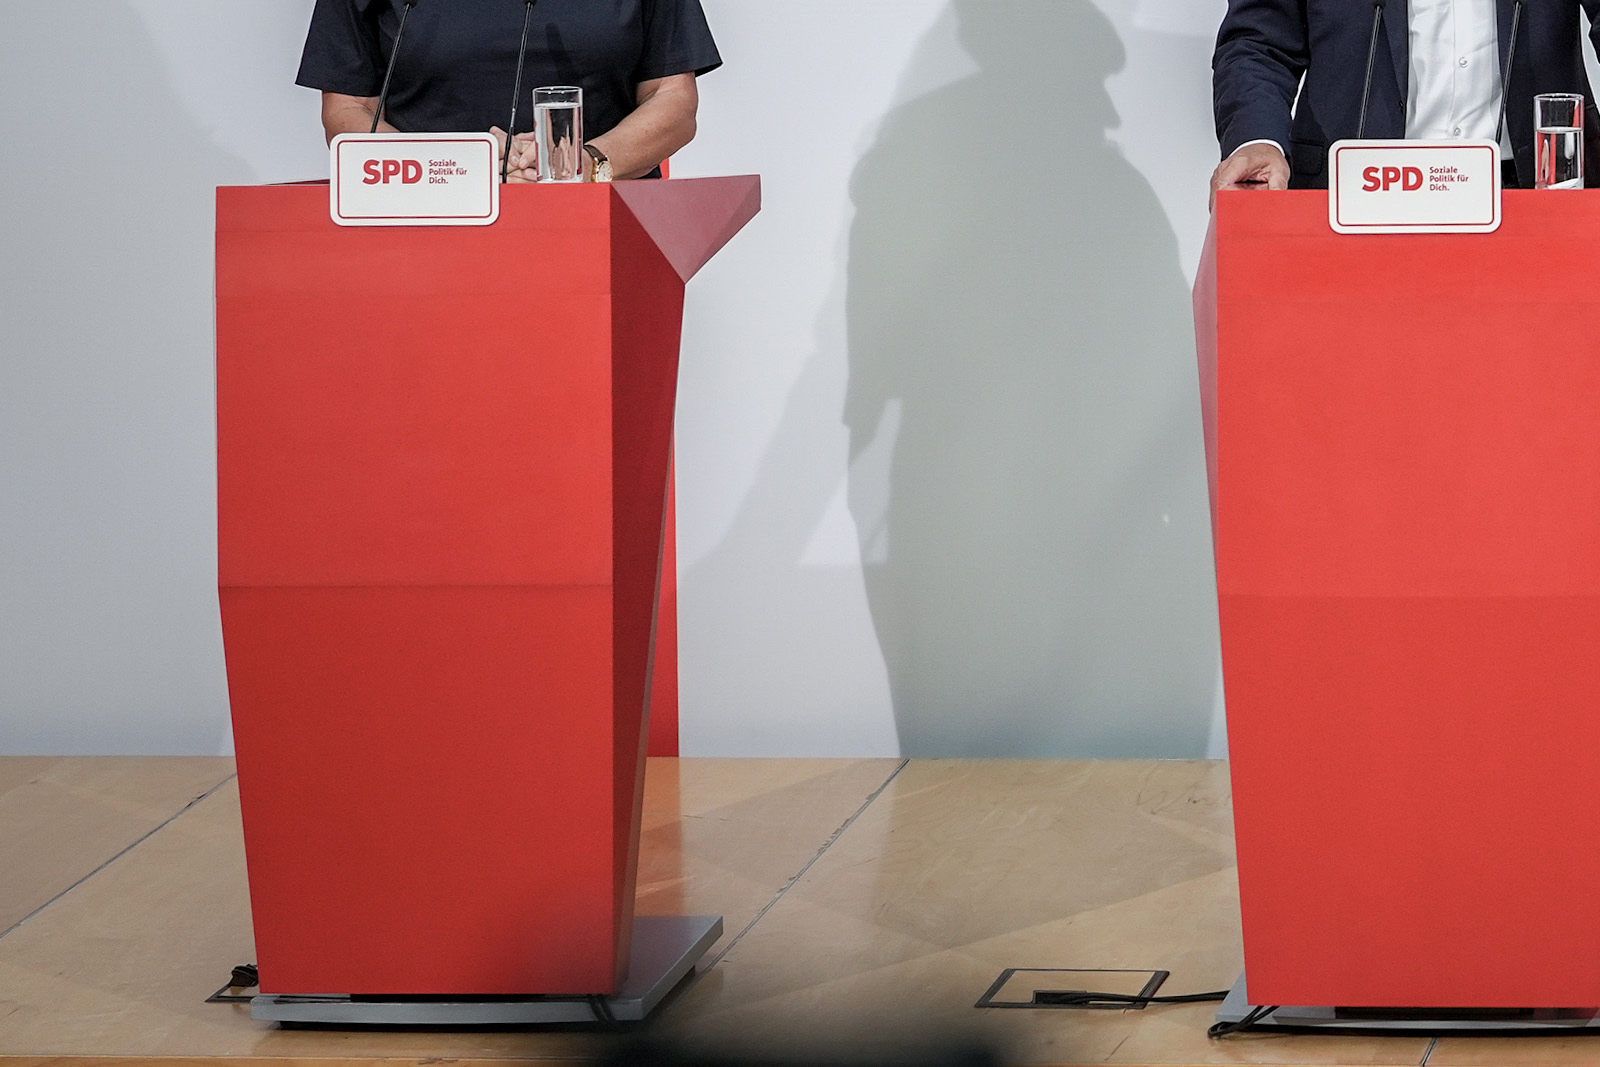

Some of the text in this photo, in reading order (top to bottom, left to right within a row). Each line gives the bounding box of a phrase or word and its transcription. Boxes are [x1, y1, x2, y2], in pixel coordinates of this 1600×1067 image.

[428, 159, 457, 167] Soziale
[362, 159, 423, 185] SPD
[428, 167, 468, 176] Politik für
[1429, 166, 1459, 174] Soziale
[1362, 166, 1424, 192] SPD
[1429, 174, 1469, 183] Politik für
[1429, 183, 1450, 191] Dich.
